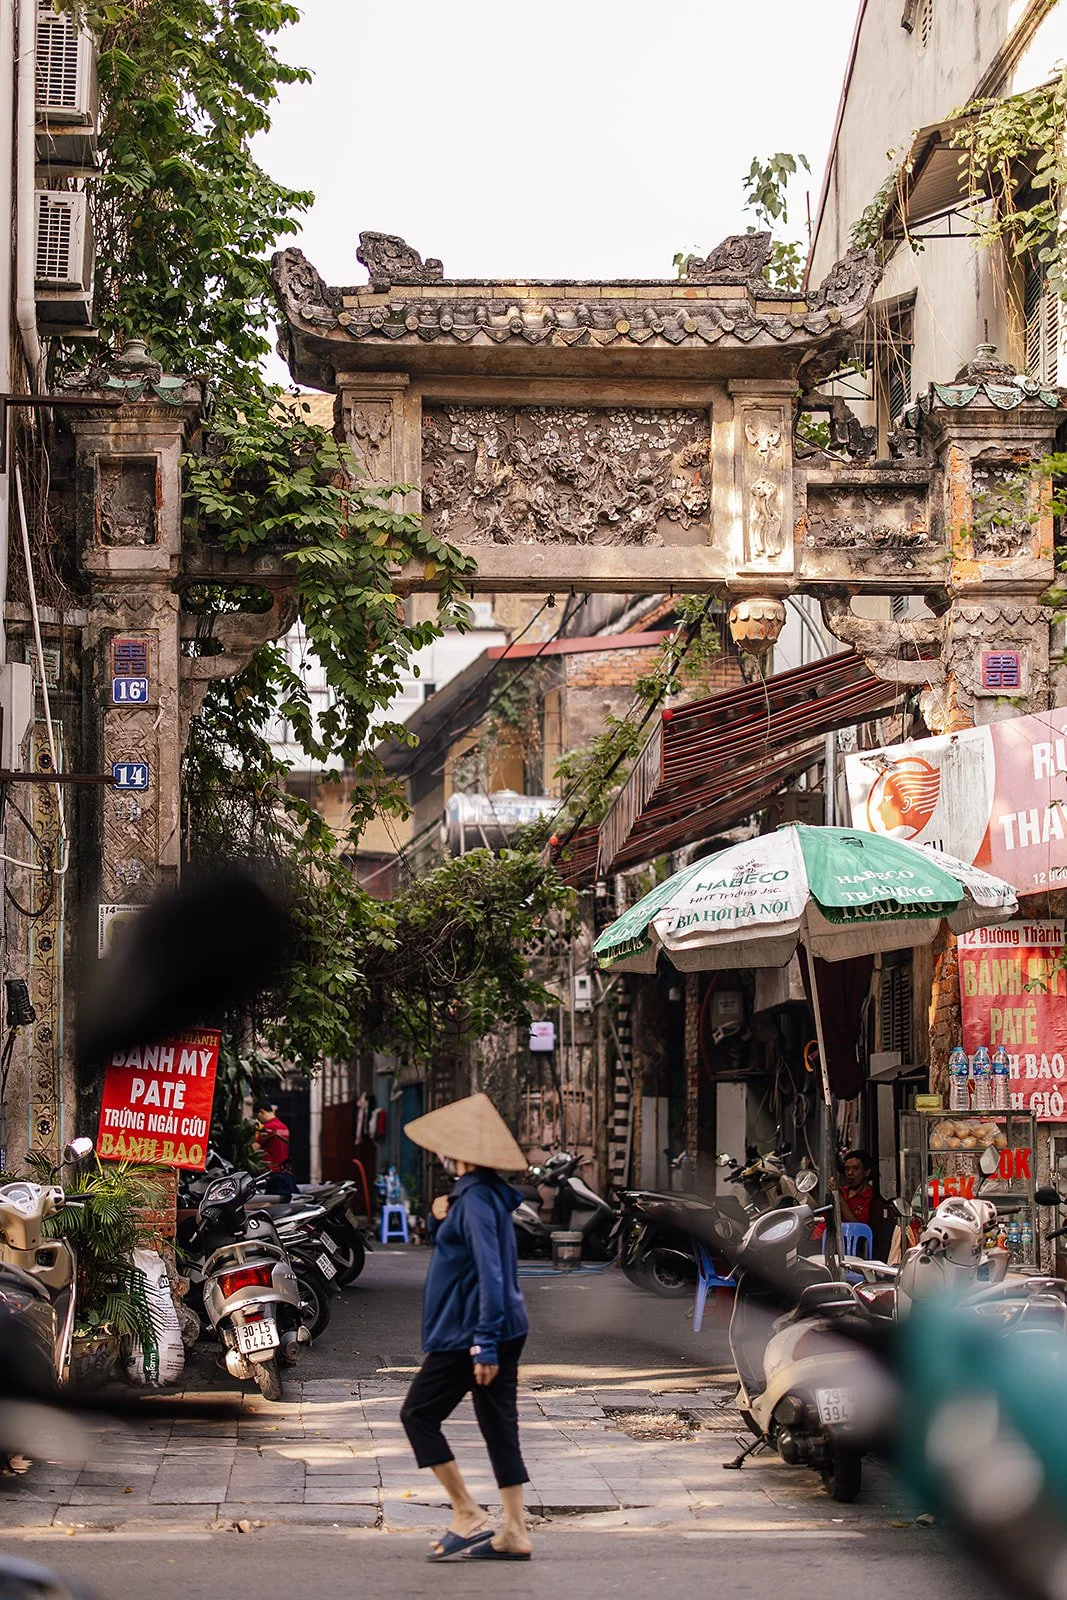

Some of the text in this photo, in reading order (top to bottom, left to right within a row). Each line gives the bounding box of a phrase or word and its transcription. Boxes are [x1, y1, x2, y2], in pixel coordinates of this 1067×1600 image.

[117, 766, 145, 785] 14
[695, 870, 789, 892] HABECO
[834, 870, 914, 884] HABECO
[1033, 871, 1046, 885] 12
[841, 885, 935, 902] TRADING
[105, 906, 116, 914] 14
[676, 912, 700, 929] BIA
[1023, 926, 1062, 943] Thành
[964, 951, 1021, 997] BÁNH
[990, 1000, 1038, 1045] PATÊ
[177, 1048, 213, 1077] MỲ
[1025, 1053, 1065, 1079] BAO
[130, 1078, 187, 1110] PATÊ
[1030, 1084, 1064, 1117] GIÒ
[104, 1107, 207, 1138] TRỨNG NGẢI CỨU
[161, 1140, 202, 1165] BAO
[988, 1147, 1032, 1180] 0K
[928, 1177, 976, 1209] 15K
[242, 1321, 271, 1338] 30-L5
[244, 1334, 274, 1350] 0443
